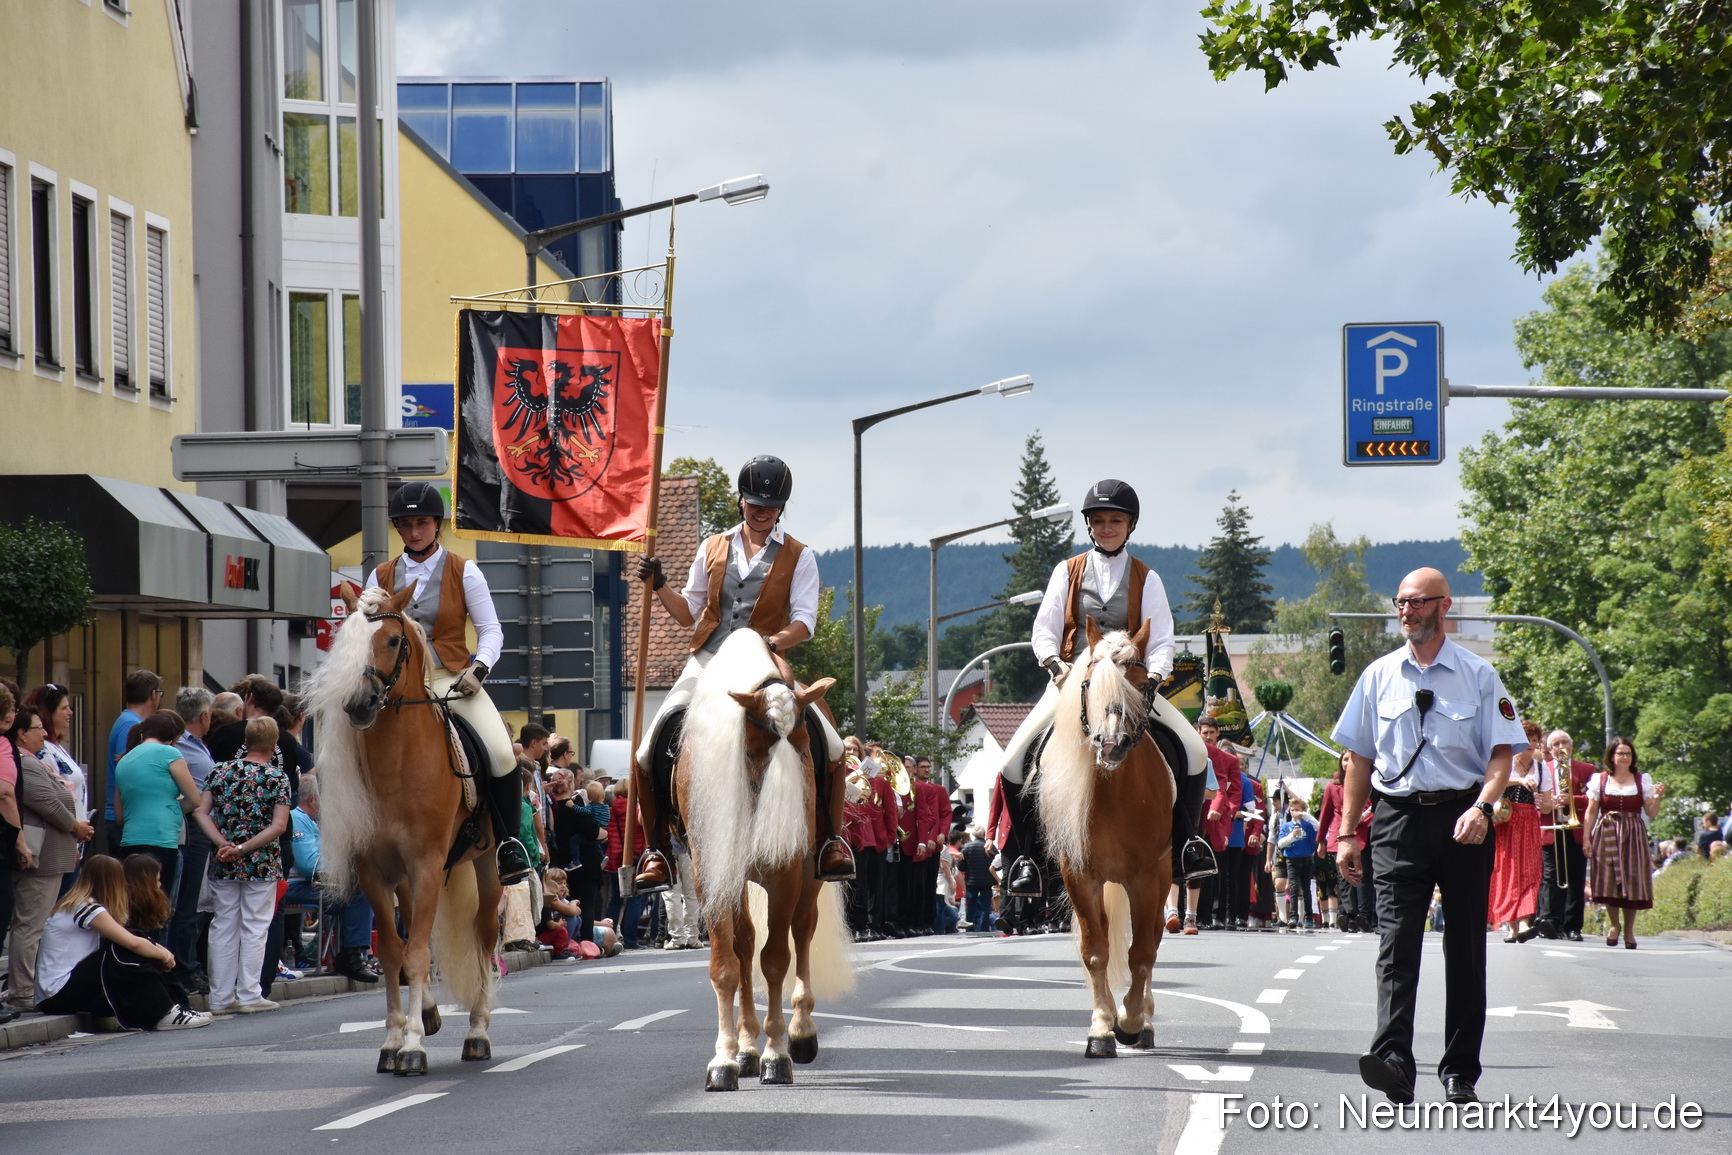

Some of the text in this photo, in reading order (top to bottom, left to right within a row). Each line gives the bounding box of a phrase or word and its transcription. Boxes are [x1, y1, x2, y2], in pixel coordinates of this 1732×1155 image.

[1376, 348, 1409, 395] P
[1352, 398, 1433, 414] Ringstraße
[1374, 420, 1411, 430] EINFAHRT
